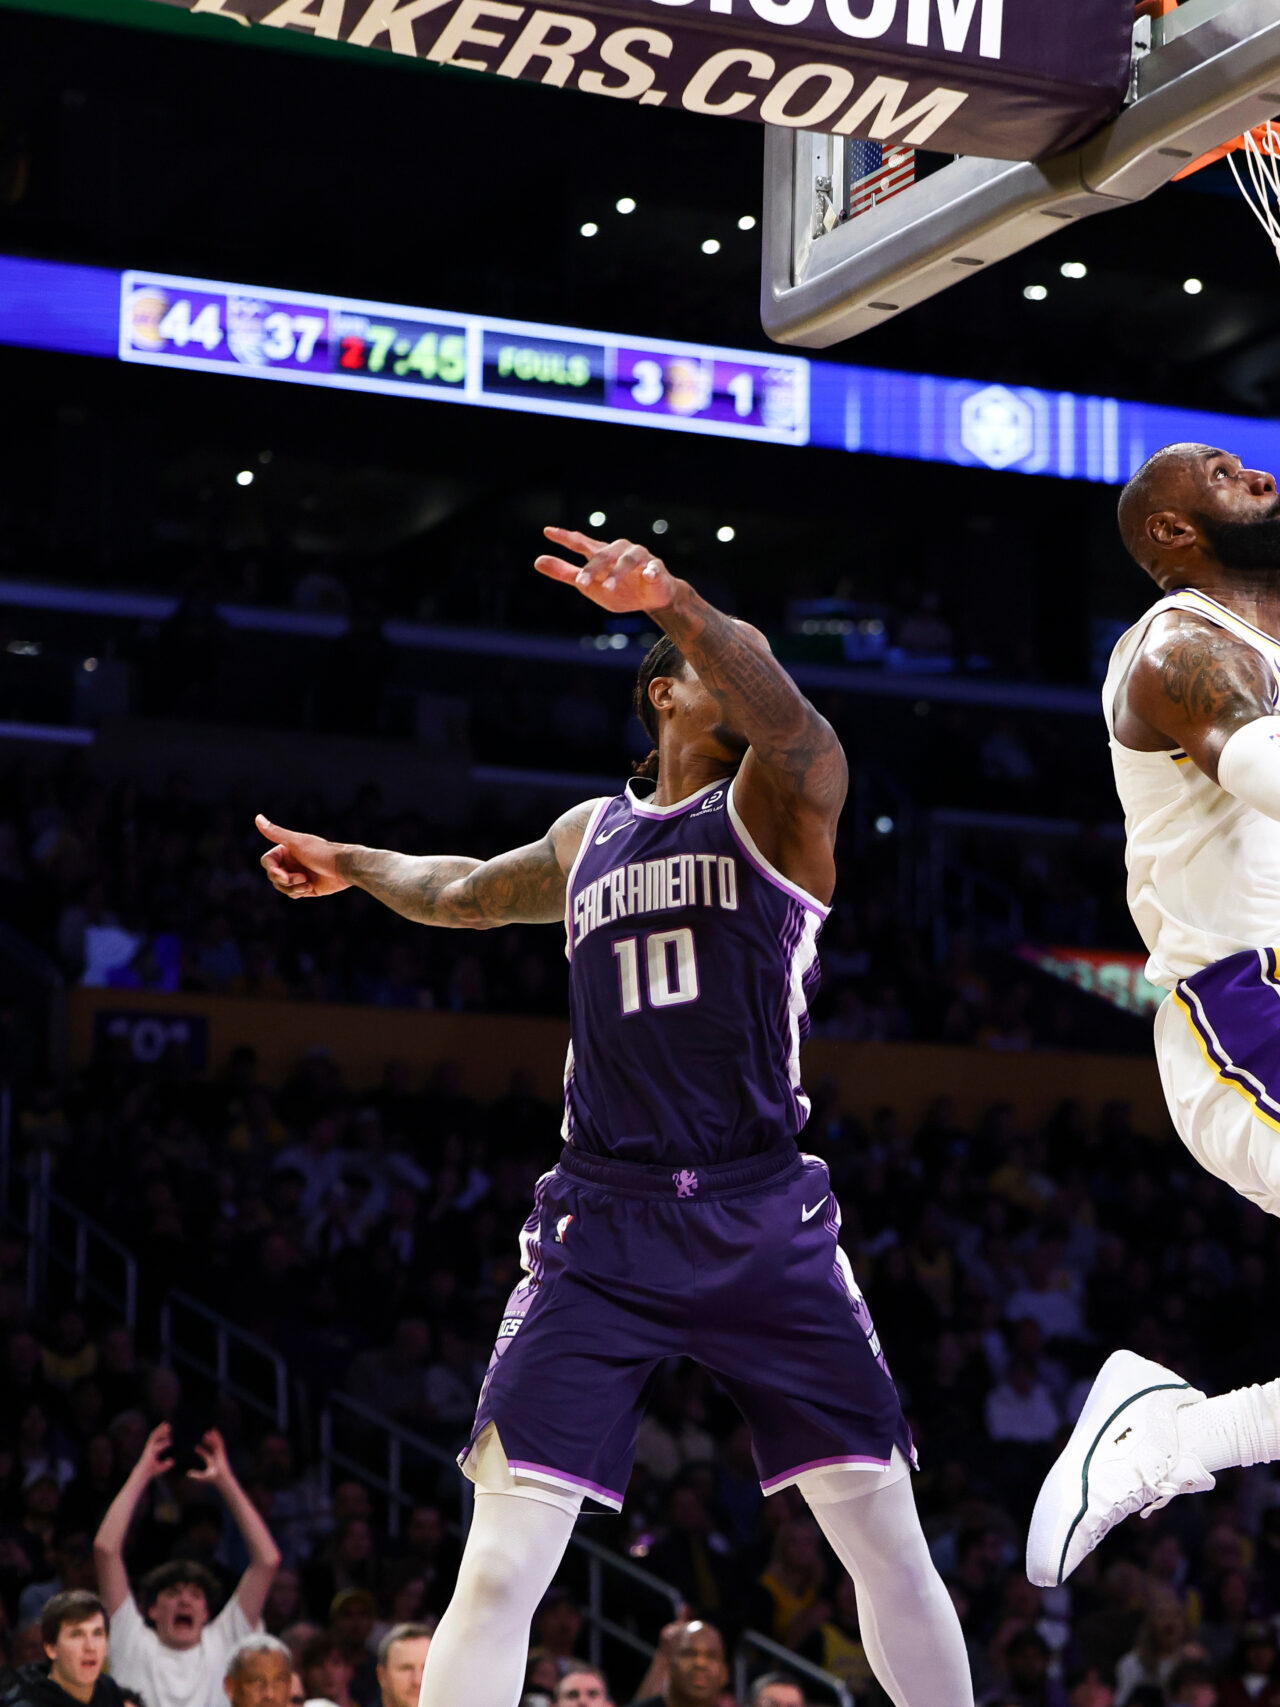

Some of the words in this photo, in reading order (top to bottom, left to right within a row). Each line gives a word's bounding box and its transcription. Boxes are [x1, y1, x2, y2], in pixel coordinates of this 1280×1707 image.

[158, 299, 223, 351] 44
[263, 311, 326, 363] 37
[366, 324, 465, 384] 7:45
[498, 346, 591, 387] FOULS
[630, 360, 664, 406] 3
[726, 372, 754, 418] 1
[573, 853, 740, 950] SACRAMENTO
[610, 926, 700, 1017] 10
